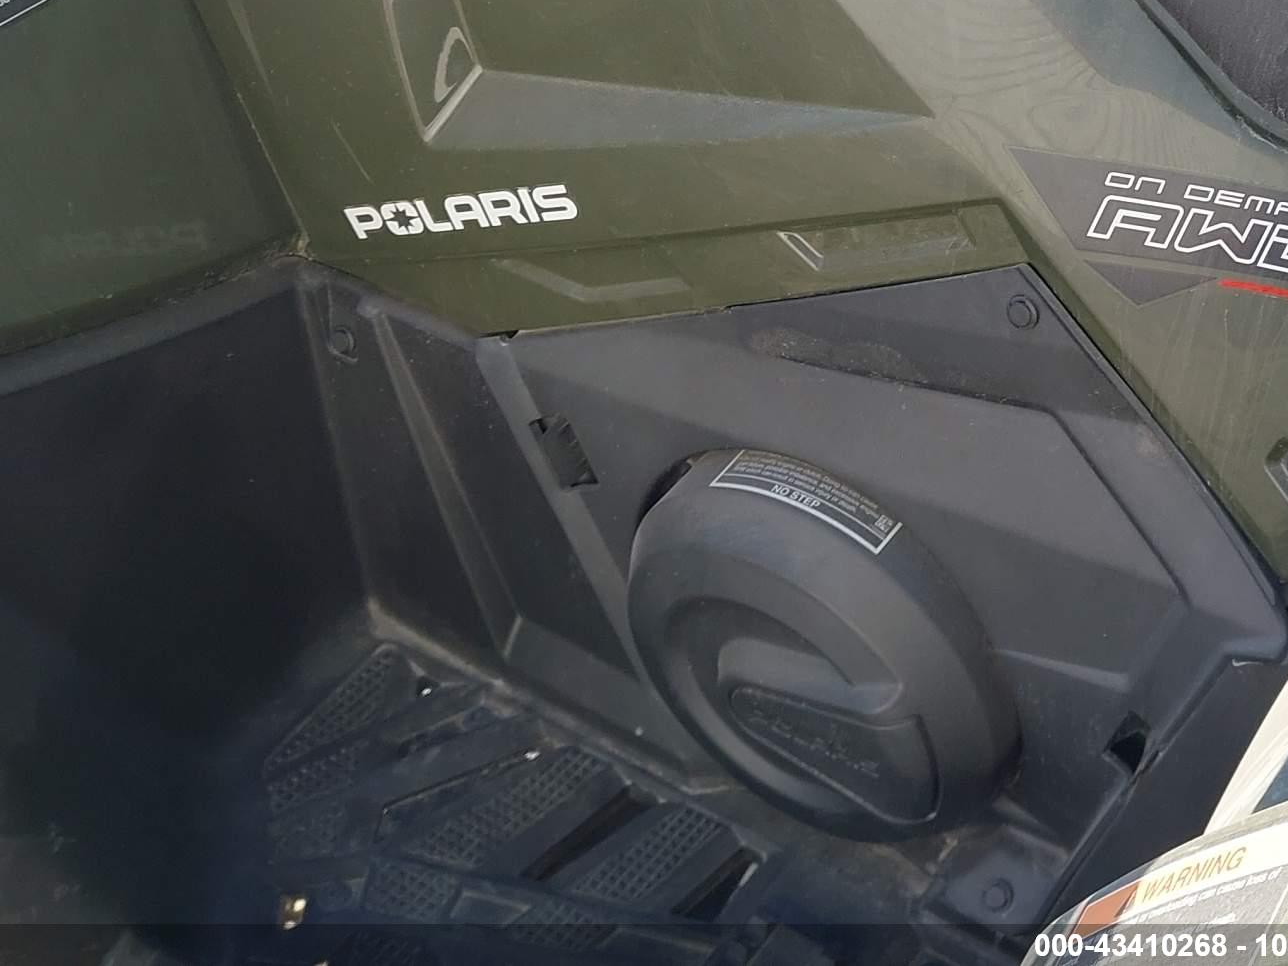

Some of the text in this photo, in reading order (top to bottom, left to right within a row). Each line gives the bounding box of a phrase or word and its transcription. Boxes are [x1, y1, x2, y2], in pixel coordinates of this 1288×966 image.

[1104, 171, 1166, 194] ON
[343, 184, 578, 240] POLARIS
[771, 484, 820, 507] NO STEP
[1142, 846, 1247, 902] WARNING
